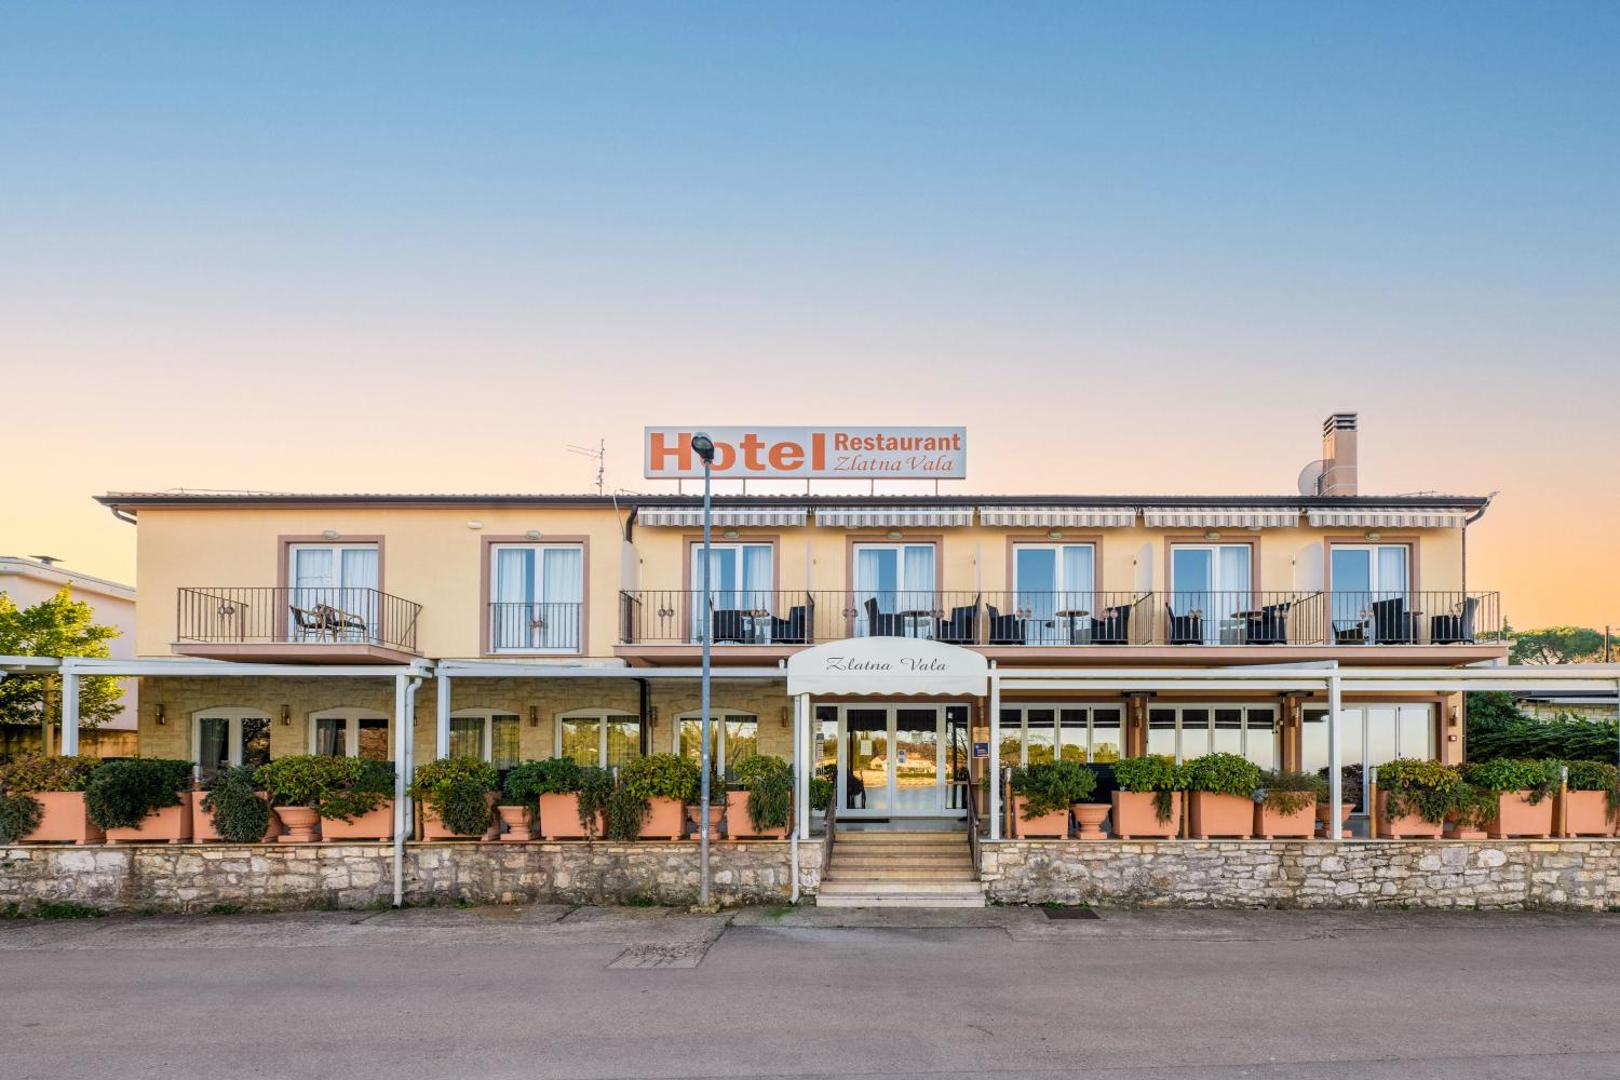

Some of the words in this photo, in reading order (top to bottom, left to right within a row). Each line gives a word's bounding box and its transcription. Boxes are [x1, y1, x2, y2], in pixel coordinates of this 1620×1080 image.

[834, 432, 961, 451] Restaurant
[650, 432, 826, 472] Hotel
[833, 454, 901, 472] Zlatna
[905, 454, 953, 472] Vala
[826, 656, 892, 672] Zlatna
[900, 656, 948, 671] Vala
